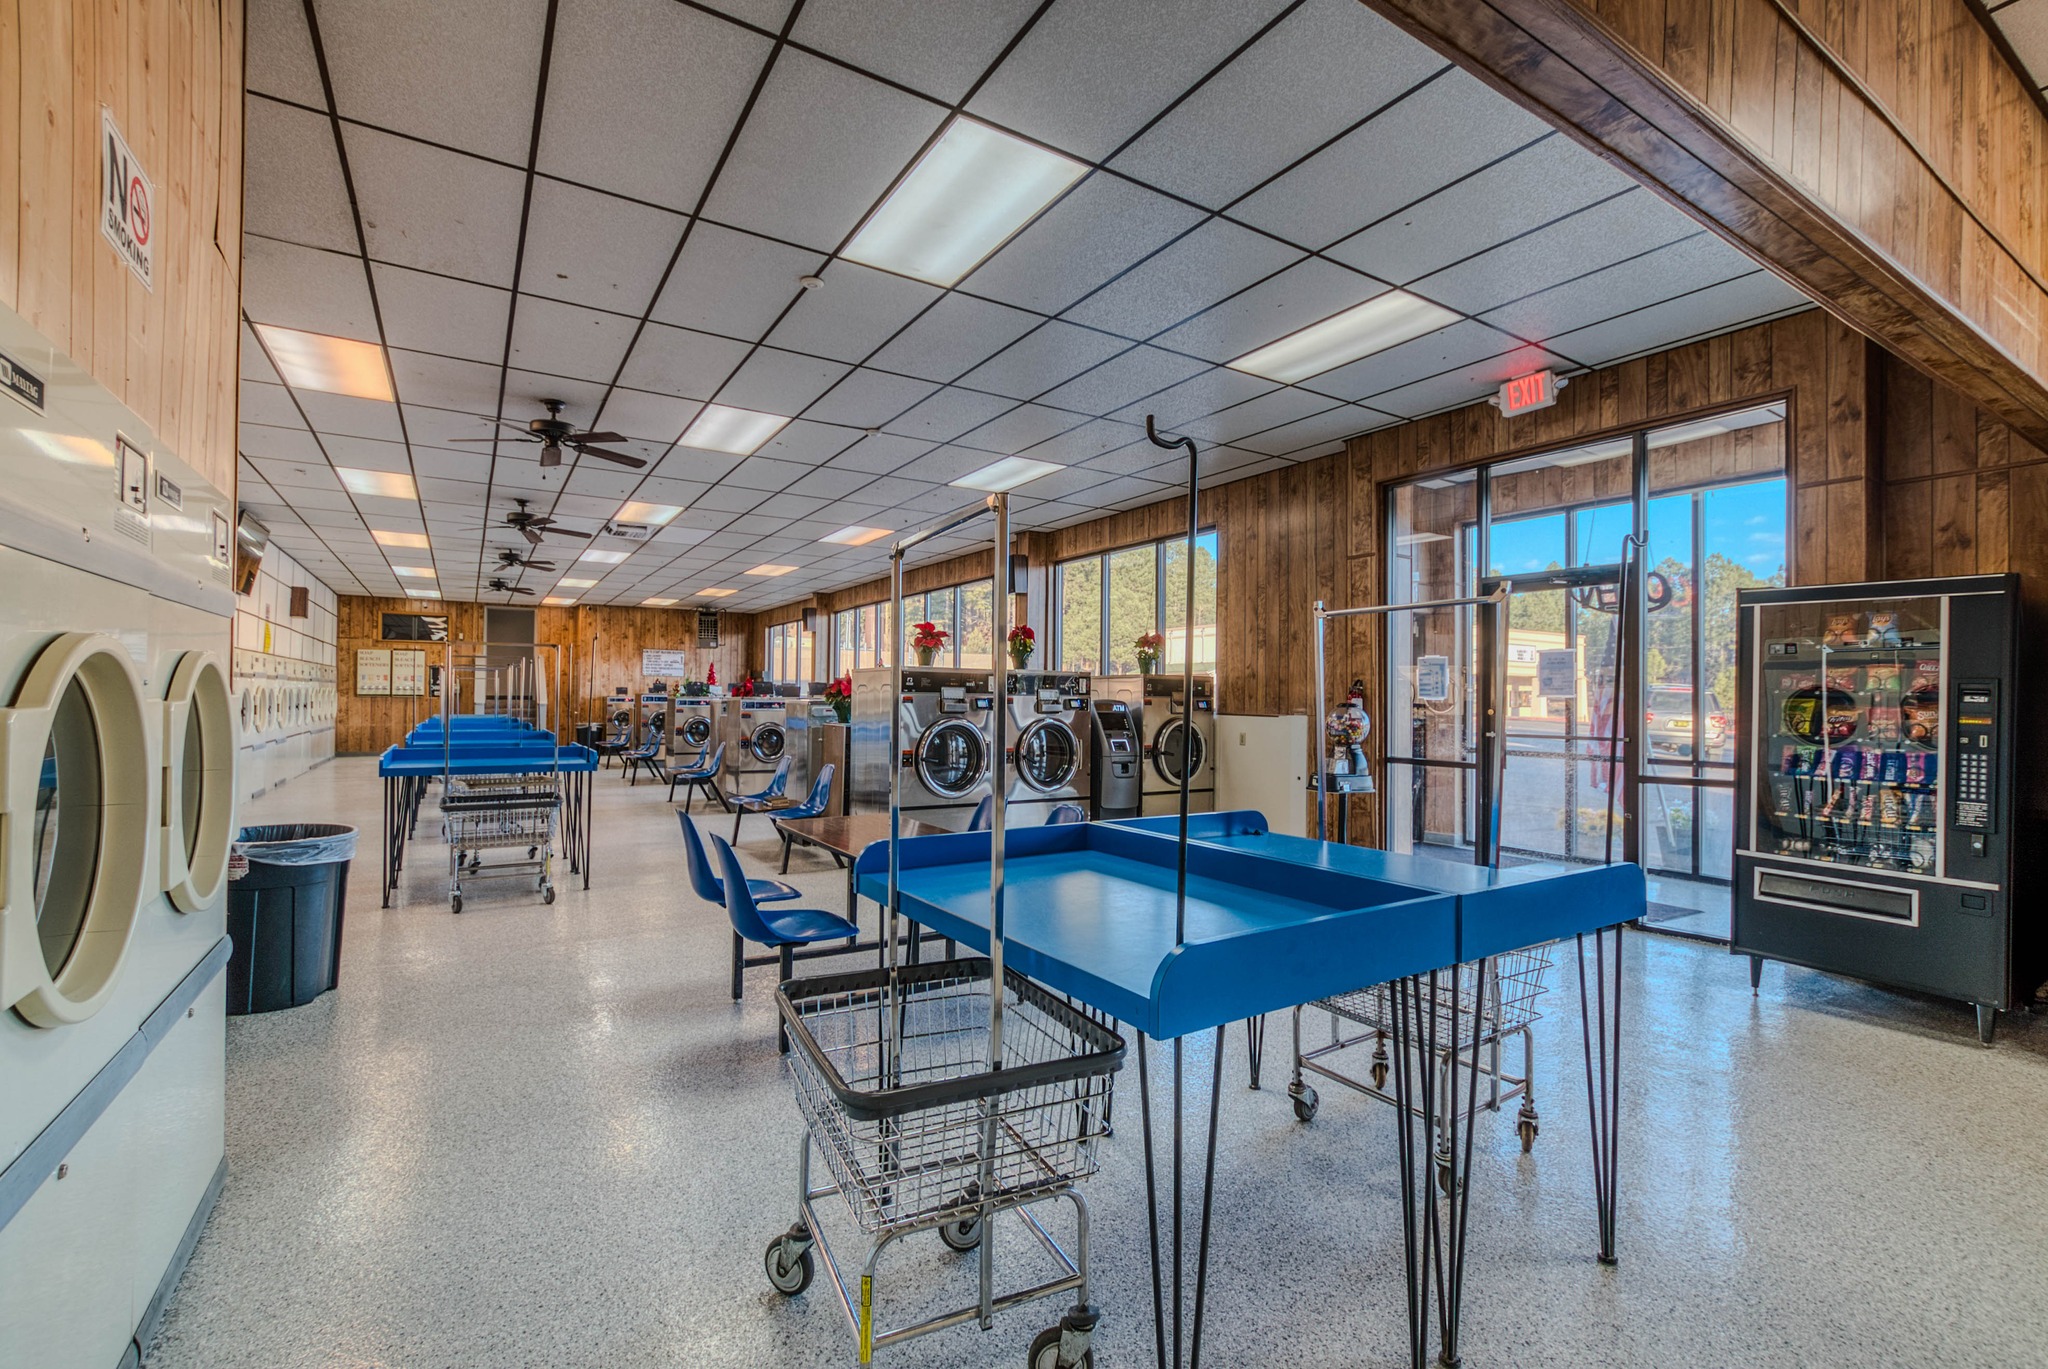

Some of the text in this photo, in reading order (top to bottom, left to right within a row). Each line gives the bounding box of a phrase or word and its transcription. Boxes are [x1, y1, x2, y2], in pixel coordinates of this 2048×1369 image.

[107, 206, 150, 277] SMOKING
[12, 371, 39, 399] MAYTAG
[1507, 372, 1546, 411] EXIT
[1112, 704, 1125, 712] ATM
